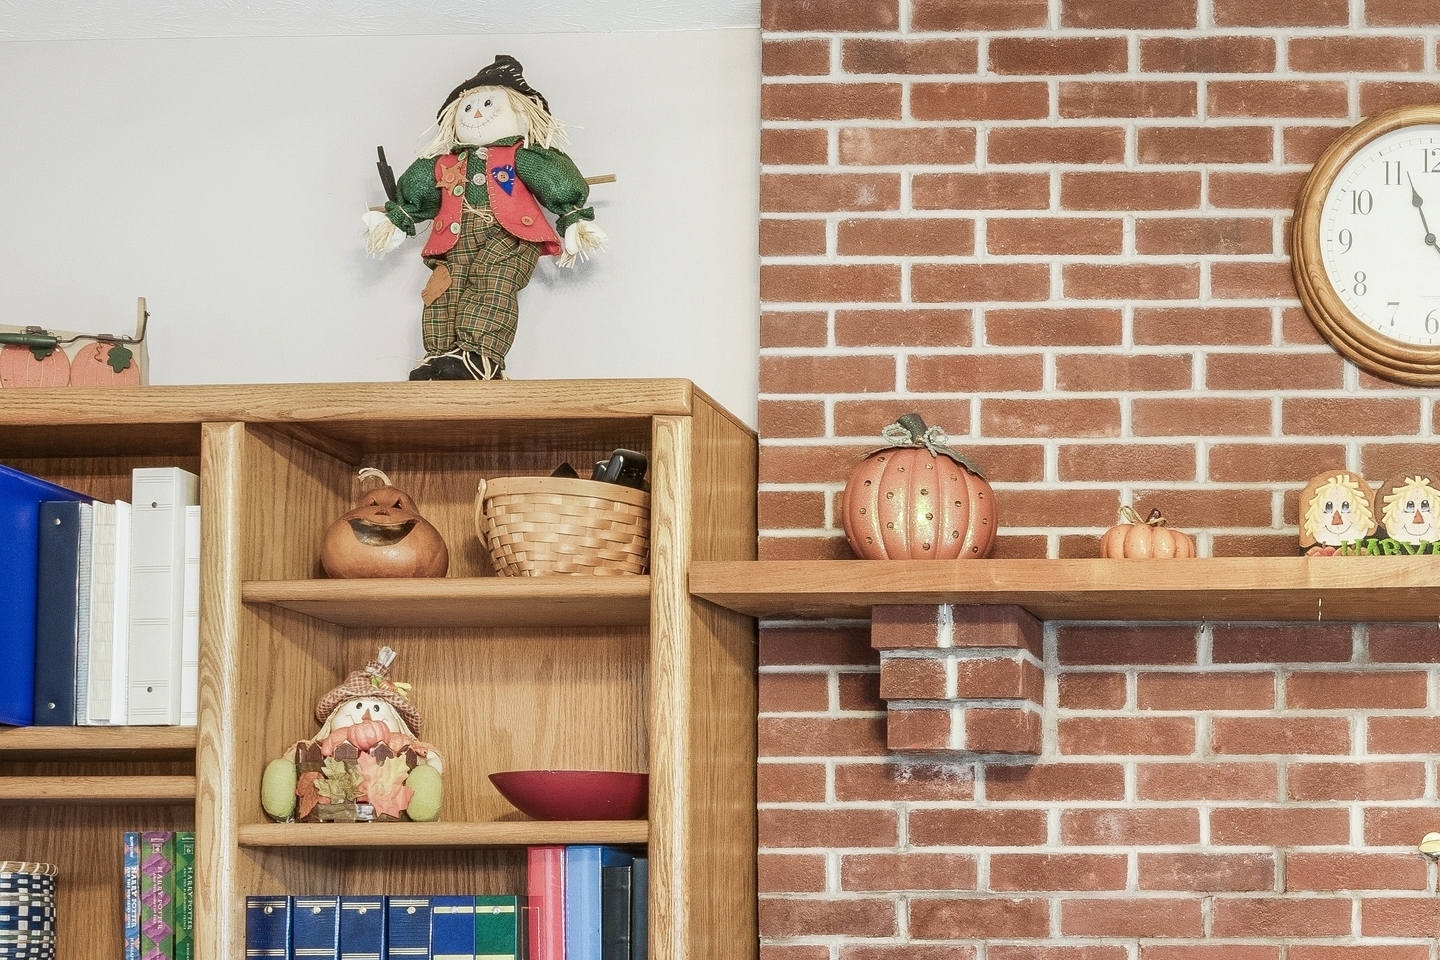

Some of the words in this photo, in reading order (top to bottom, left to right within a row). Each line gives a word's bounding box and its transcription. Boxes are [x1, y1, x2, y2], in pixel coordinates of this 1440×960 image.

[1383, 160, 1403, 185] 11
[1350, 189, 1373, 215] 10
[1338, 228, 1353, 255] 9
[1353, 271, 1367, 296] 8
[1387, 302, 1400, 326] 7
[1425, 309, 1439, 334] 6
